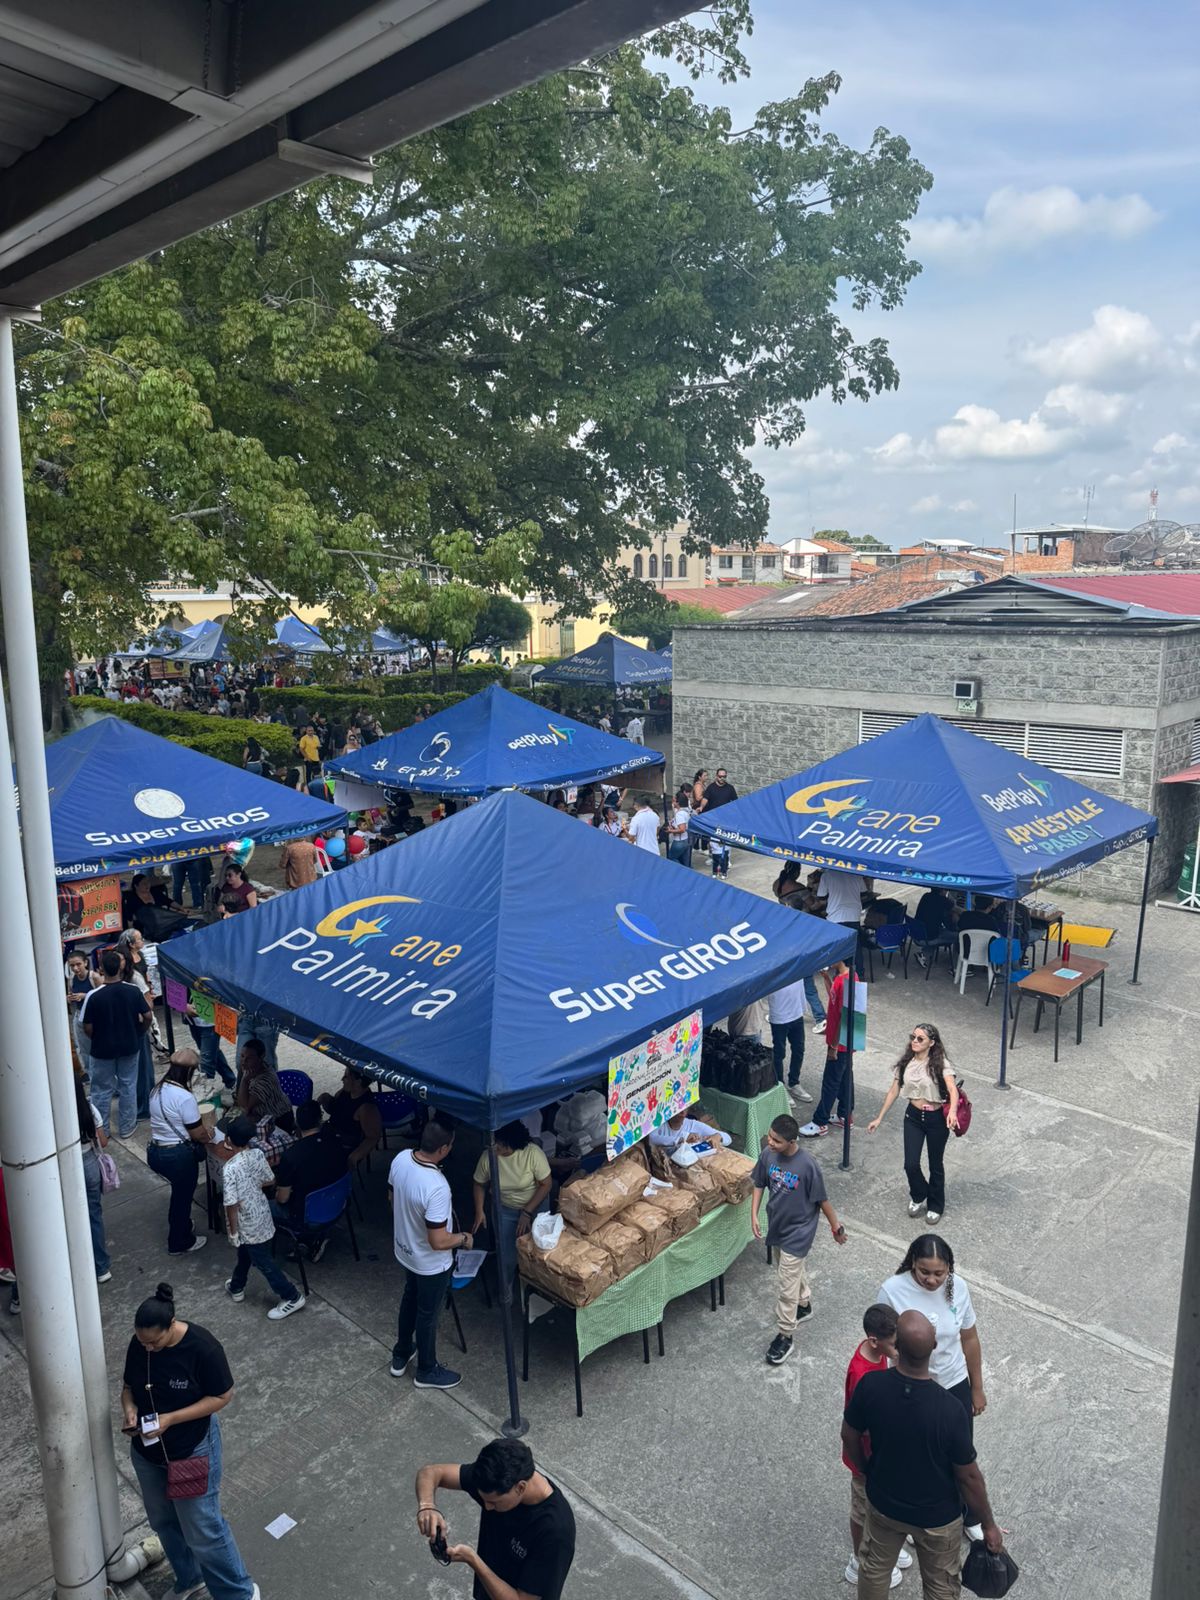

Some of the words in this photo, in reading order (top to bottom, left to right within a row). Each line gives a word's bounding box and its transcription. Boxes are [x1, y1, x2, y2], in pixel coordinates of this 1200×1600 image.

[981, 787, 1043, 813] BetPlay
[797, 820, 926, 859] Palmira
[1005, 797, 1105, 846] APUÉSTALE
[54, 863, 99, 877] BetPlay
[257, 926, 458, 1021] Palmira
[363, 1060, 429, 1101] Palmira
